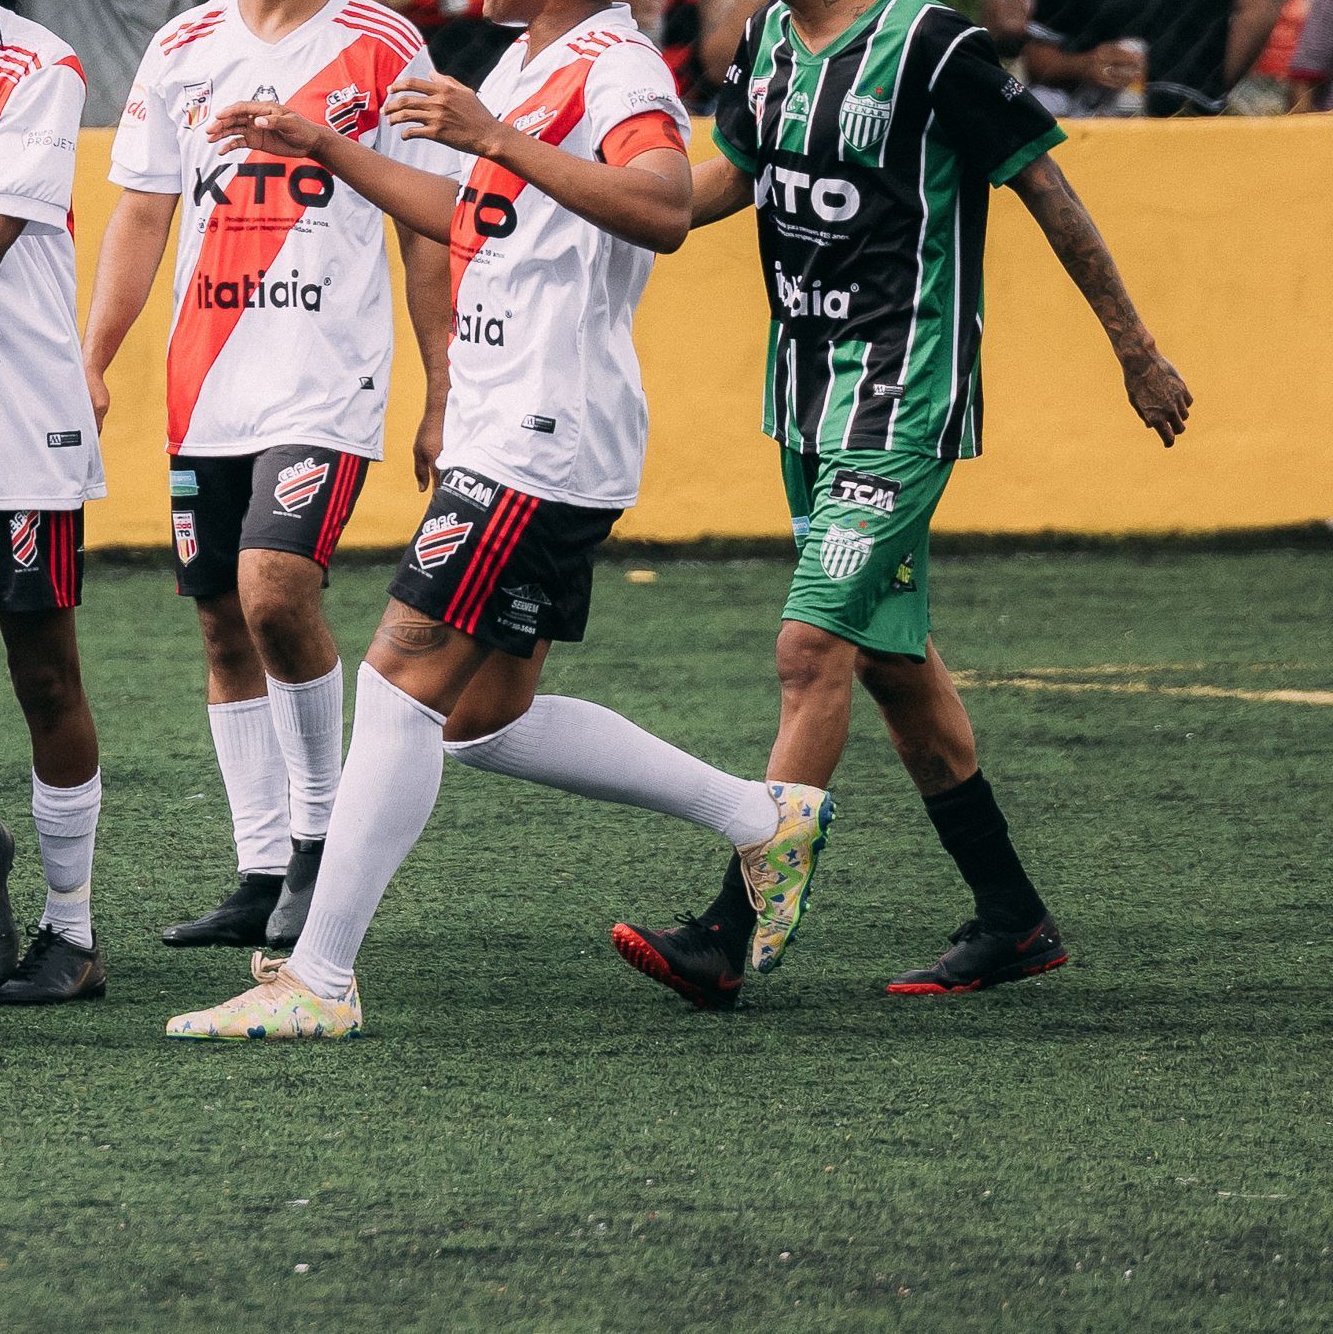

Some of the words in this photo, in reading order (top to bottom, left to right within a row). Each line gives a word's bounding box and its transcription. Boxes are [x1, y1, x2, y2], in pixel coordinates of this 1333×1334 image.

[27, 137, 75, 151] PROJET
[194, 163, 335, 208] KTO
[458, 186, 518, 239] TO
[197, 269, 323, 312] itatiaia
[449, 470, 493, 508] TCM
[840, 480, 894, 512] TCM
